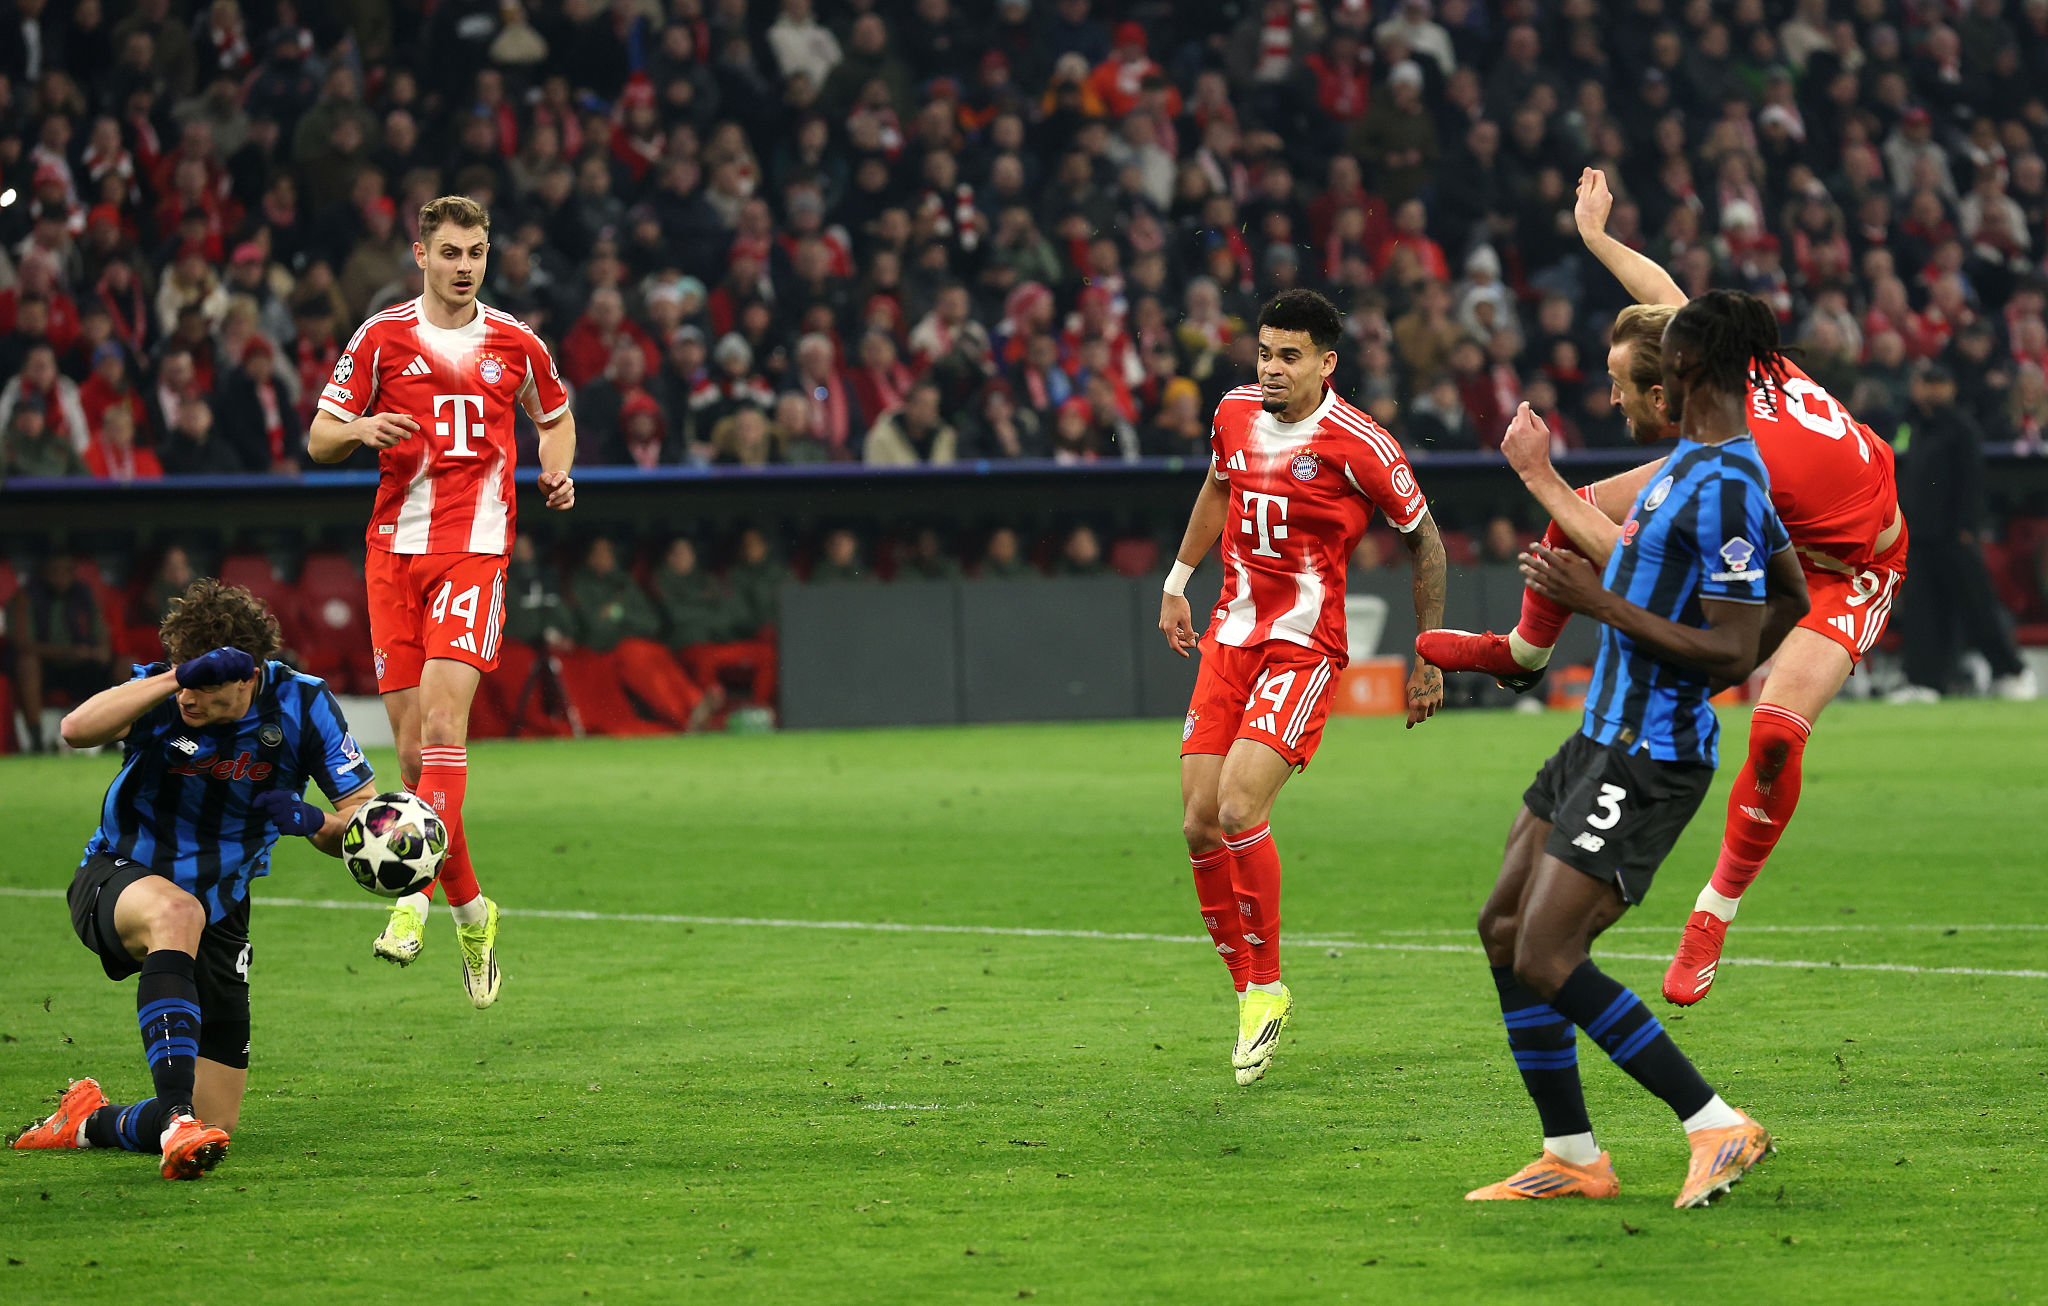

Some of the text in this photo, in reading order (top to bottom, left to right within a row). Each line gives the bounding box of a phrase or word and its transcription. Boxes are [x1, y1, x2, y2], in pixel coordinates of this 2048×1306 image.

[433, 394, 485, 457] T
[1783, 377, 1870, 464] 9
[1241, 490, 1289, 559] T
[431, 580, 481, 630] 44
[1846, 570, 1880, 607] 9
[167, 751, 273, 781] Lete
[1586, 782, 1627, 830] 3
